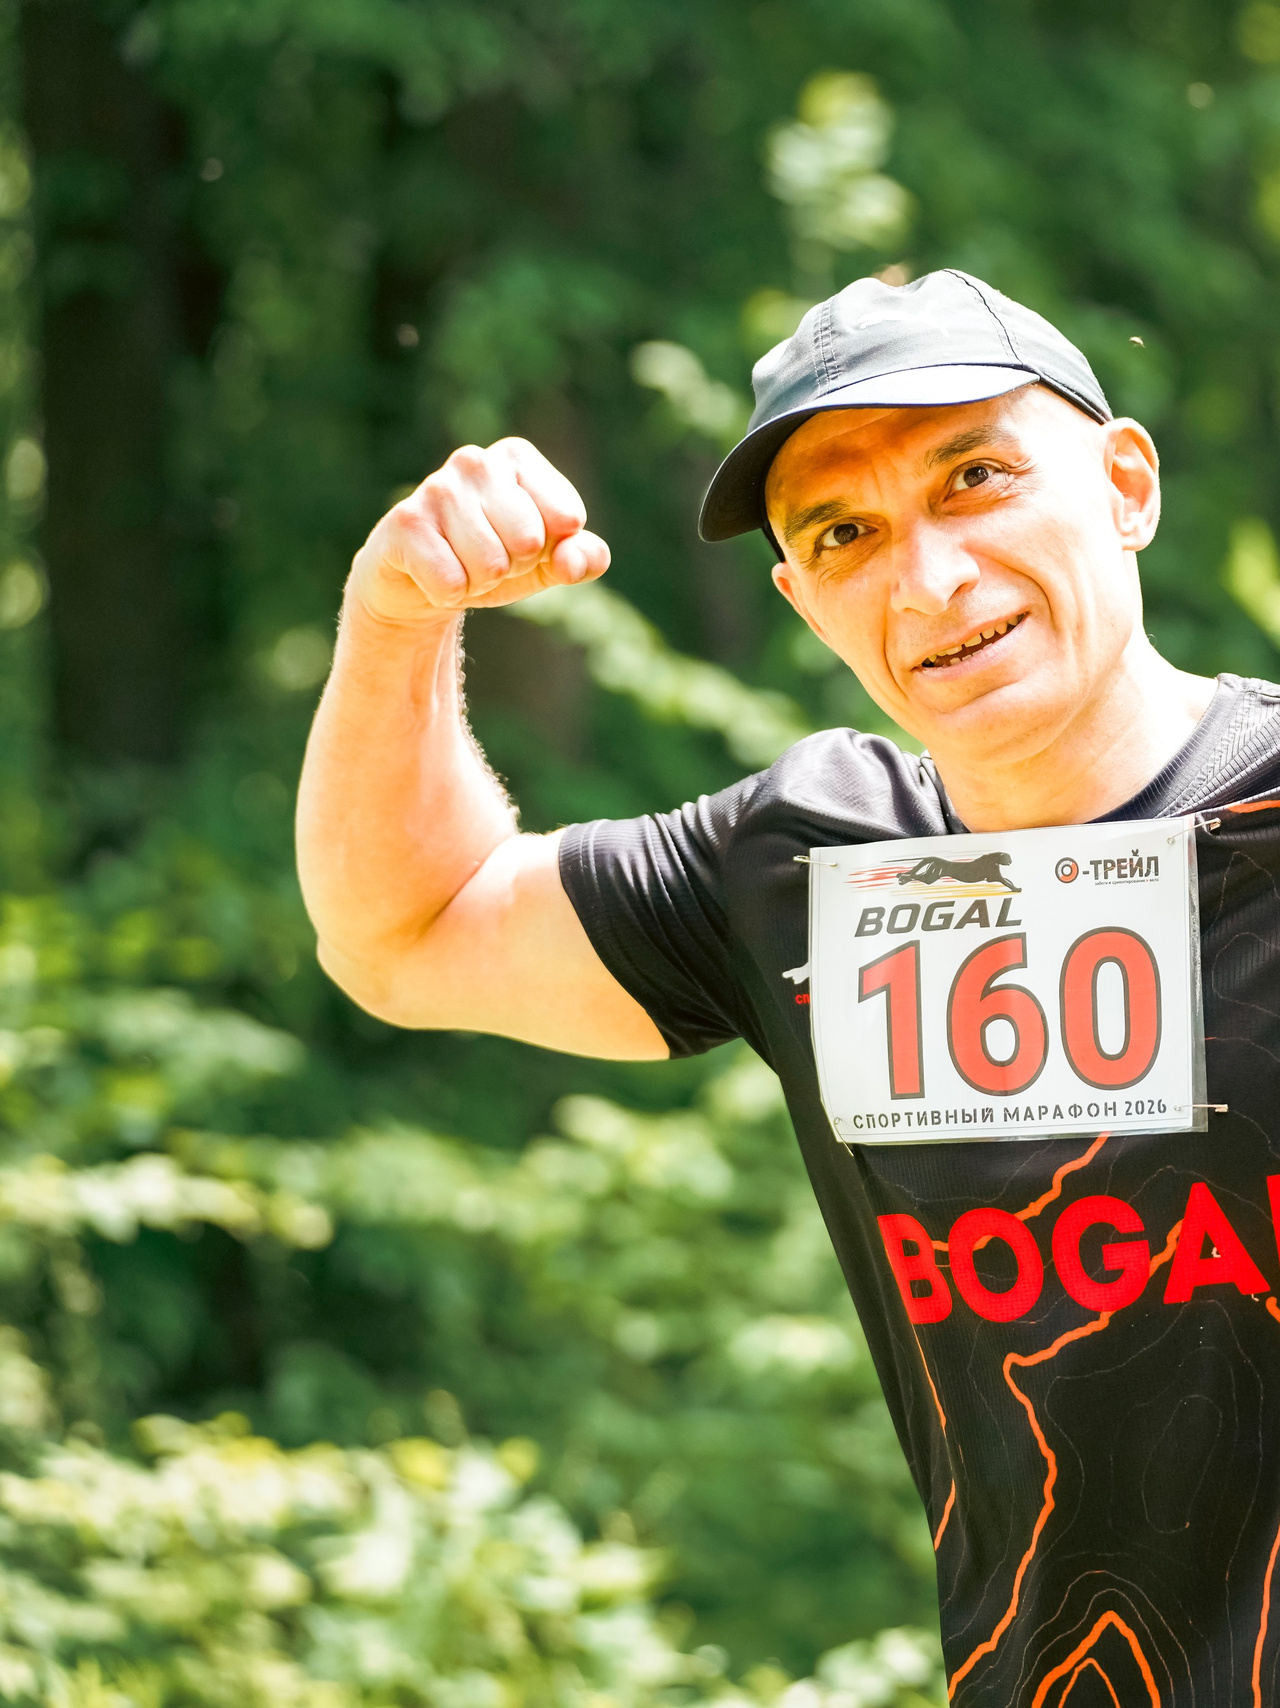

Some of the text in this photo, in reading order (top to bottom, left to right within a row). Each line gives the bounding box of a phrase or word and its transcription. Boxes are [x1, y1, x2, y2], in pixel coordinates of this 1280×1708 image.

[854, 897, 1022, 938] BOGAL
[857, 926, 1162, 1100] 160
[853, 1099, 1167, 1129] СПОРТИВНЫЙ МАРАФОН 2026
